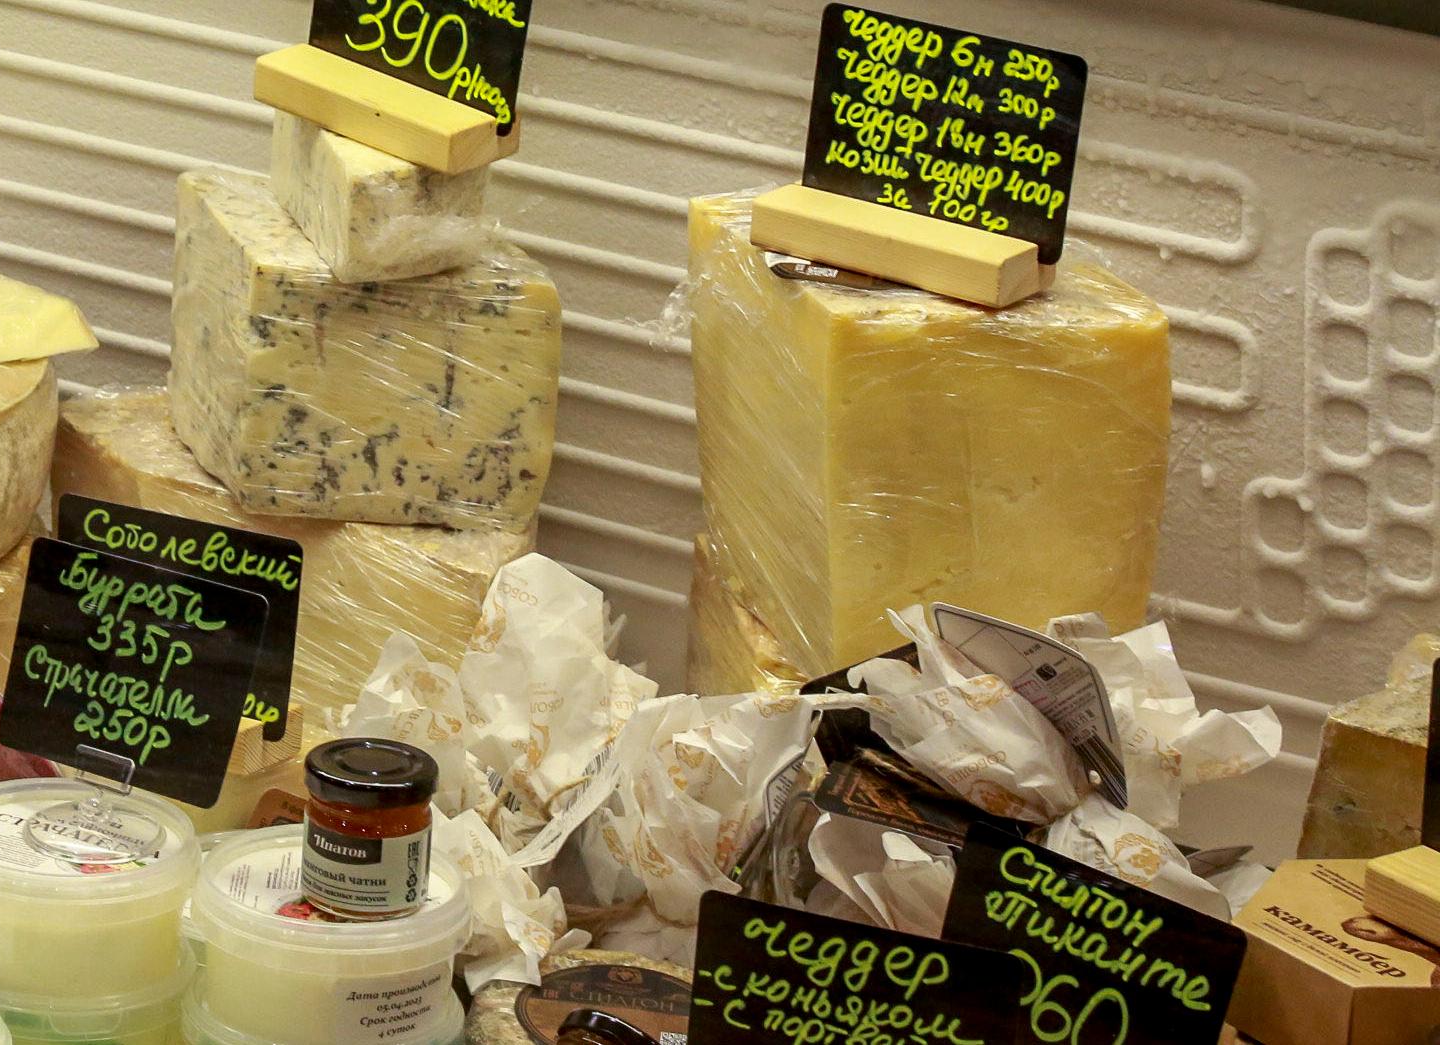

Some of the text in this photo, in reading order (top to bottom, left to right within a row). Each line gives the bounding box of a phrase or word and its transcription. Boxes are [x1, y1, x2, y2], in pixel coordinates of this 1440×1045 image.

[1003, 49, 1060, 98] 250р
[998, 88, 1056, 130] 300р
[993, 132, 1061, 177] 360р
[877, 183, 1010, 232] за 100гр
[1005, 171, 1065, 219] 400р
[83, 508, 303, 591] Соболевский
[87, 613, 193, 683] 335р
[74, 701, 171, 765] 250р
[314, 834, 367, 858] Ипатов
[349, 876, 386, 886] чатни
[1262, 905, 1406, 978] камамбер
[346, 991, 379, 1001] Дата
[743, 971, 985, 1045] коньяком
[360, 1016, 387, 1027] Срок
[386, 1023, 416, 1037] суток
